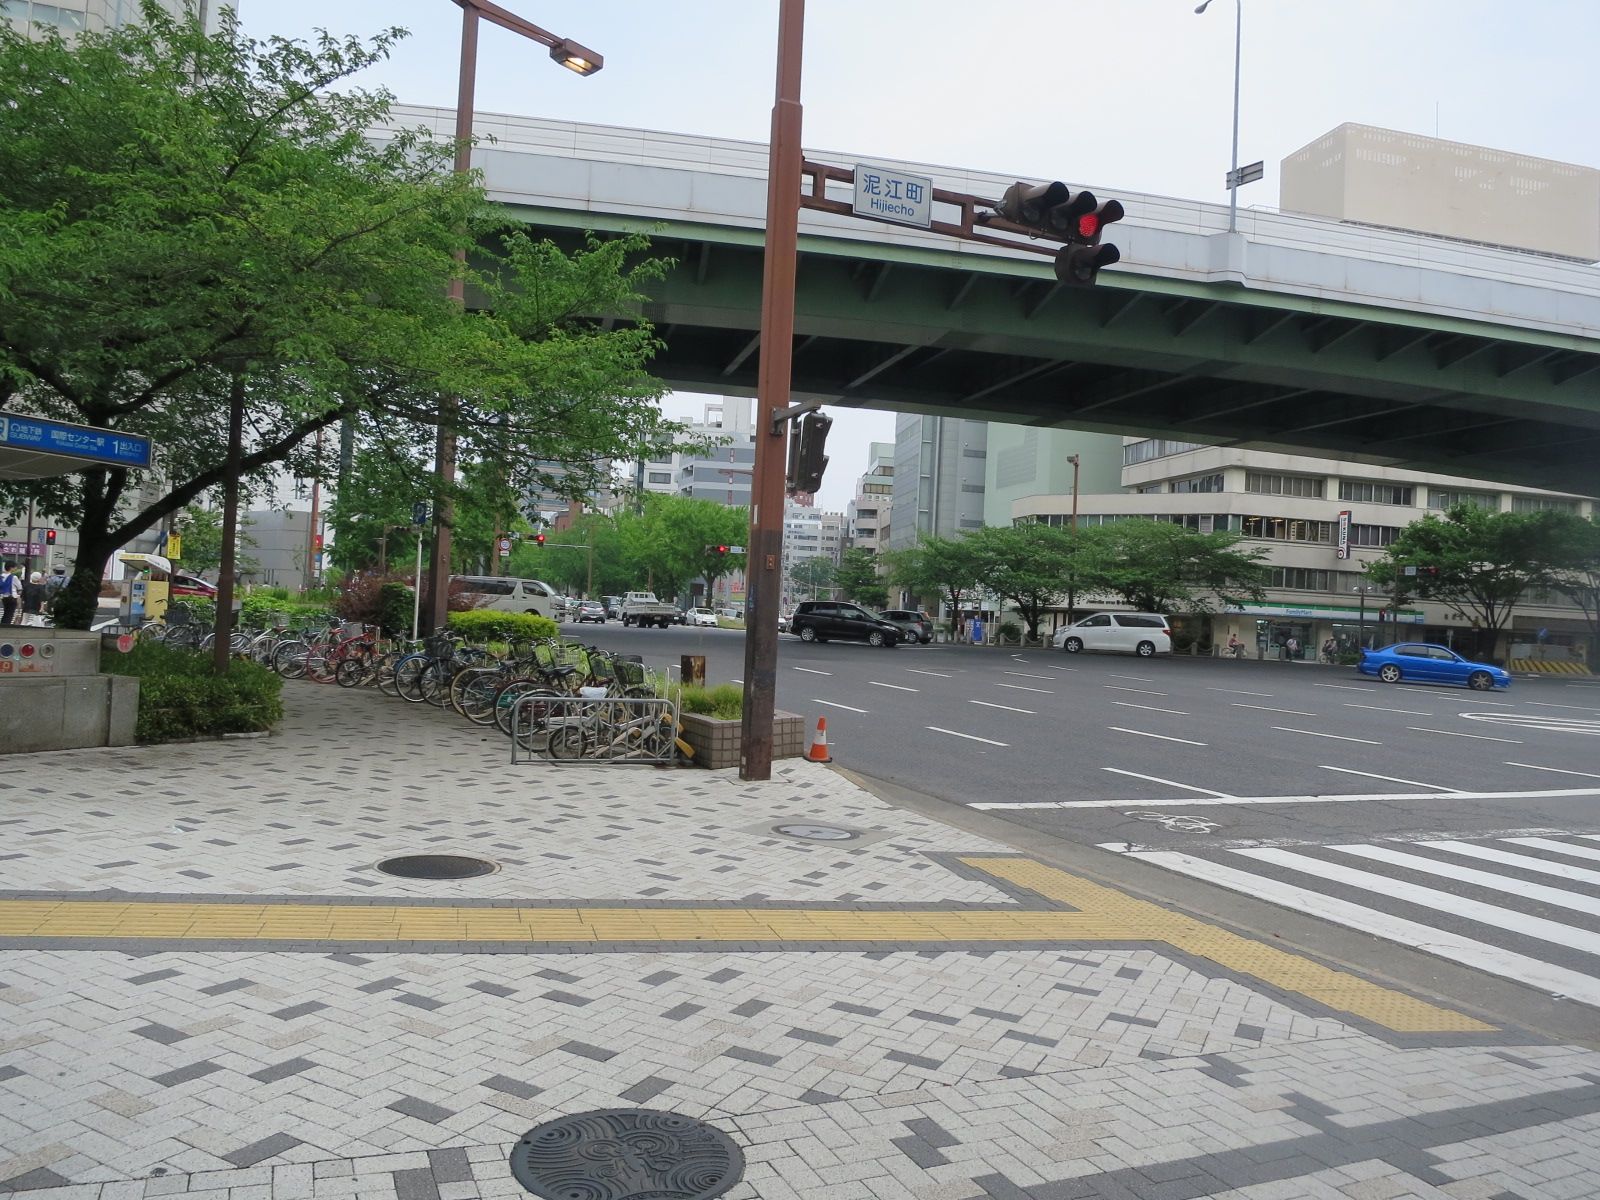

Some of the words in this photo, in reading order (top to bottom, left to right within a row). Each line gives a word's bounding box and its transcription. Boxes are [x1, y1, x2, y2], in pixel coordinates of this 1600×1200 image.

[863, 174, 924, 204] 泥江町
[870, 198, 915, 217] Hijiecho
[113, 440, 119, 454] 1
[120, 441, 142, 452] 出入口
